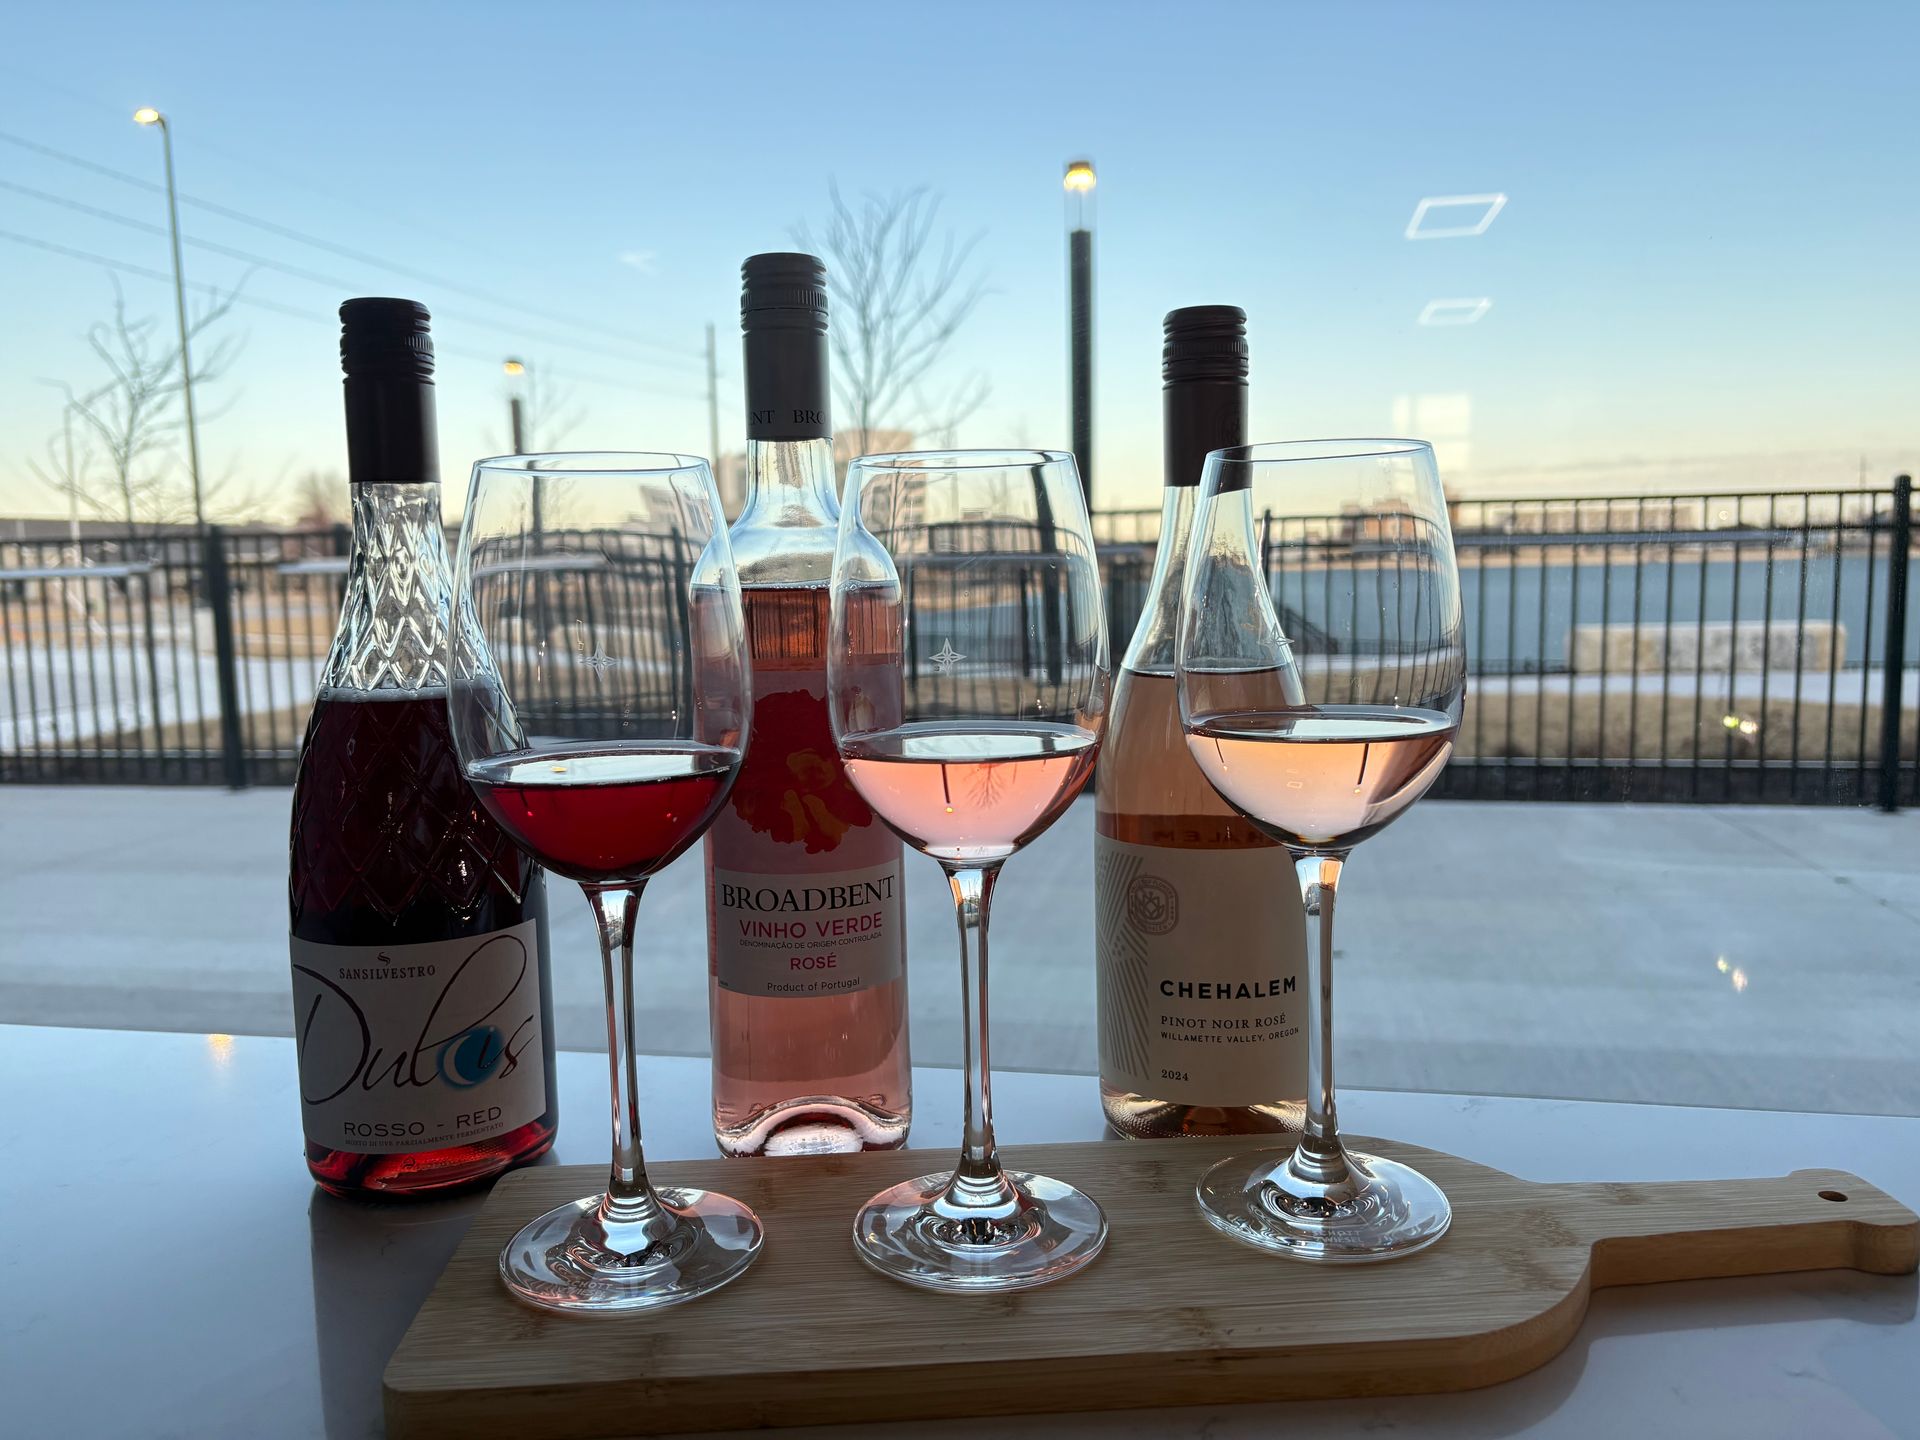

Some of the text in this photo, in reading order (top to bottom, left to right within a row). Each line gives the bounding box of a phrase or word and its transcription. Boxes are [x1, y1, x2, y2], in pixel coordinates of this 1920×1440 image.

[721, 874, 895, 912] BROADBENT
[739, 911, 883, 939] VINHO VERDE
[739, 932, 882, 950] DENOMINAÇÃO DE ORIGEM CONTROLADA
[790, 952, 837, 971] ROSÉ
[339, 964, 436, 980] SANSILVESTRO
[767, 977, 860, 992] Product of Portugal
[1160, 975, 1297, 999] CHEHALEM
[1160, 1012, 1287, 1030] PINOT NOIR ROSÉ
[1160, 1026, 1300, 1044] WILLAMETTE VALLEY, OREGON
[1161, 1069, 1190, 1082] 2024
[344, 1121, 425, 1137] ROSSO
[456, 1105, 502, 1129] RED
[395, 1134, 455, 1147] PARZIALMENTE
[456, 1121, 505, 1140] FERMENTATO
